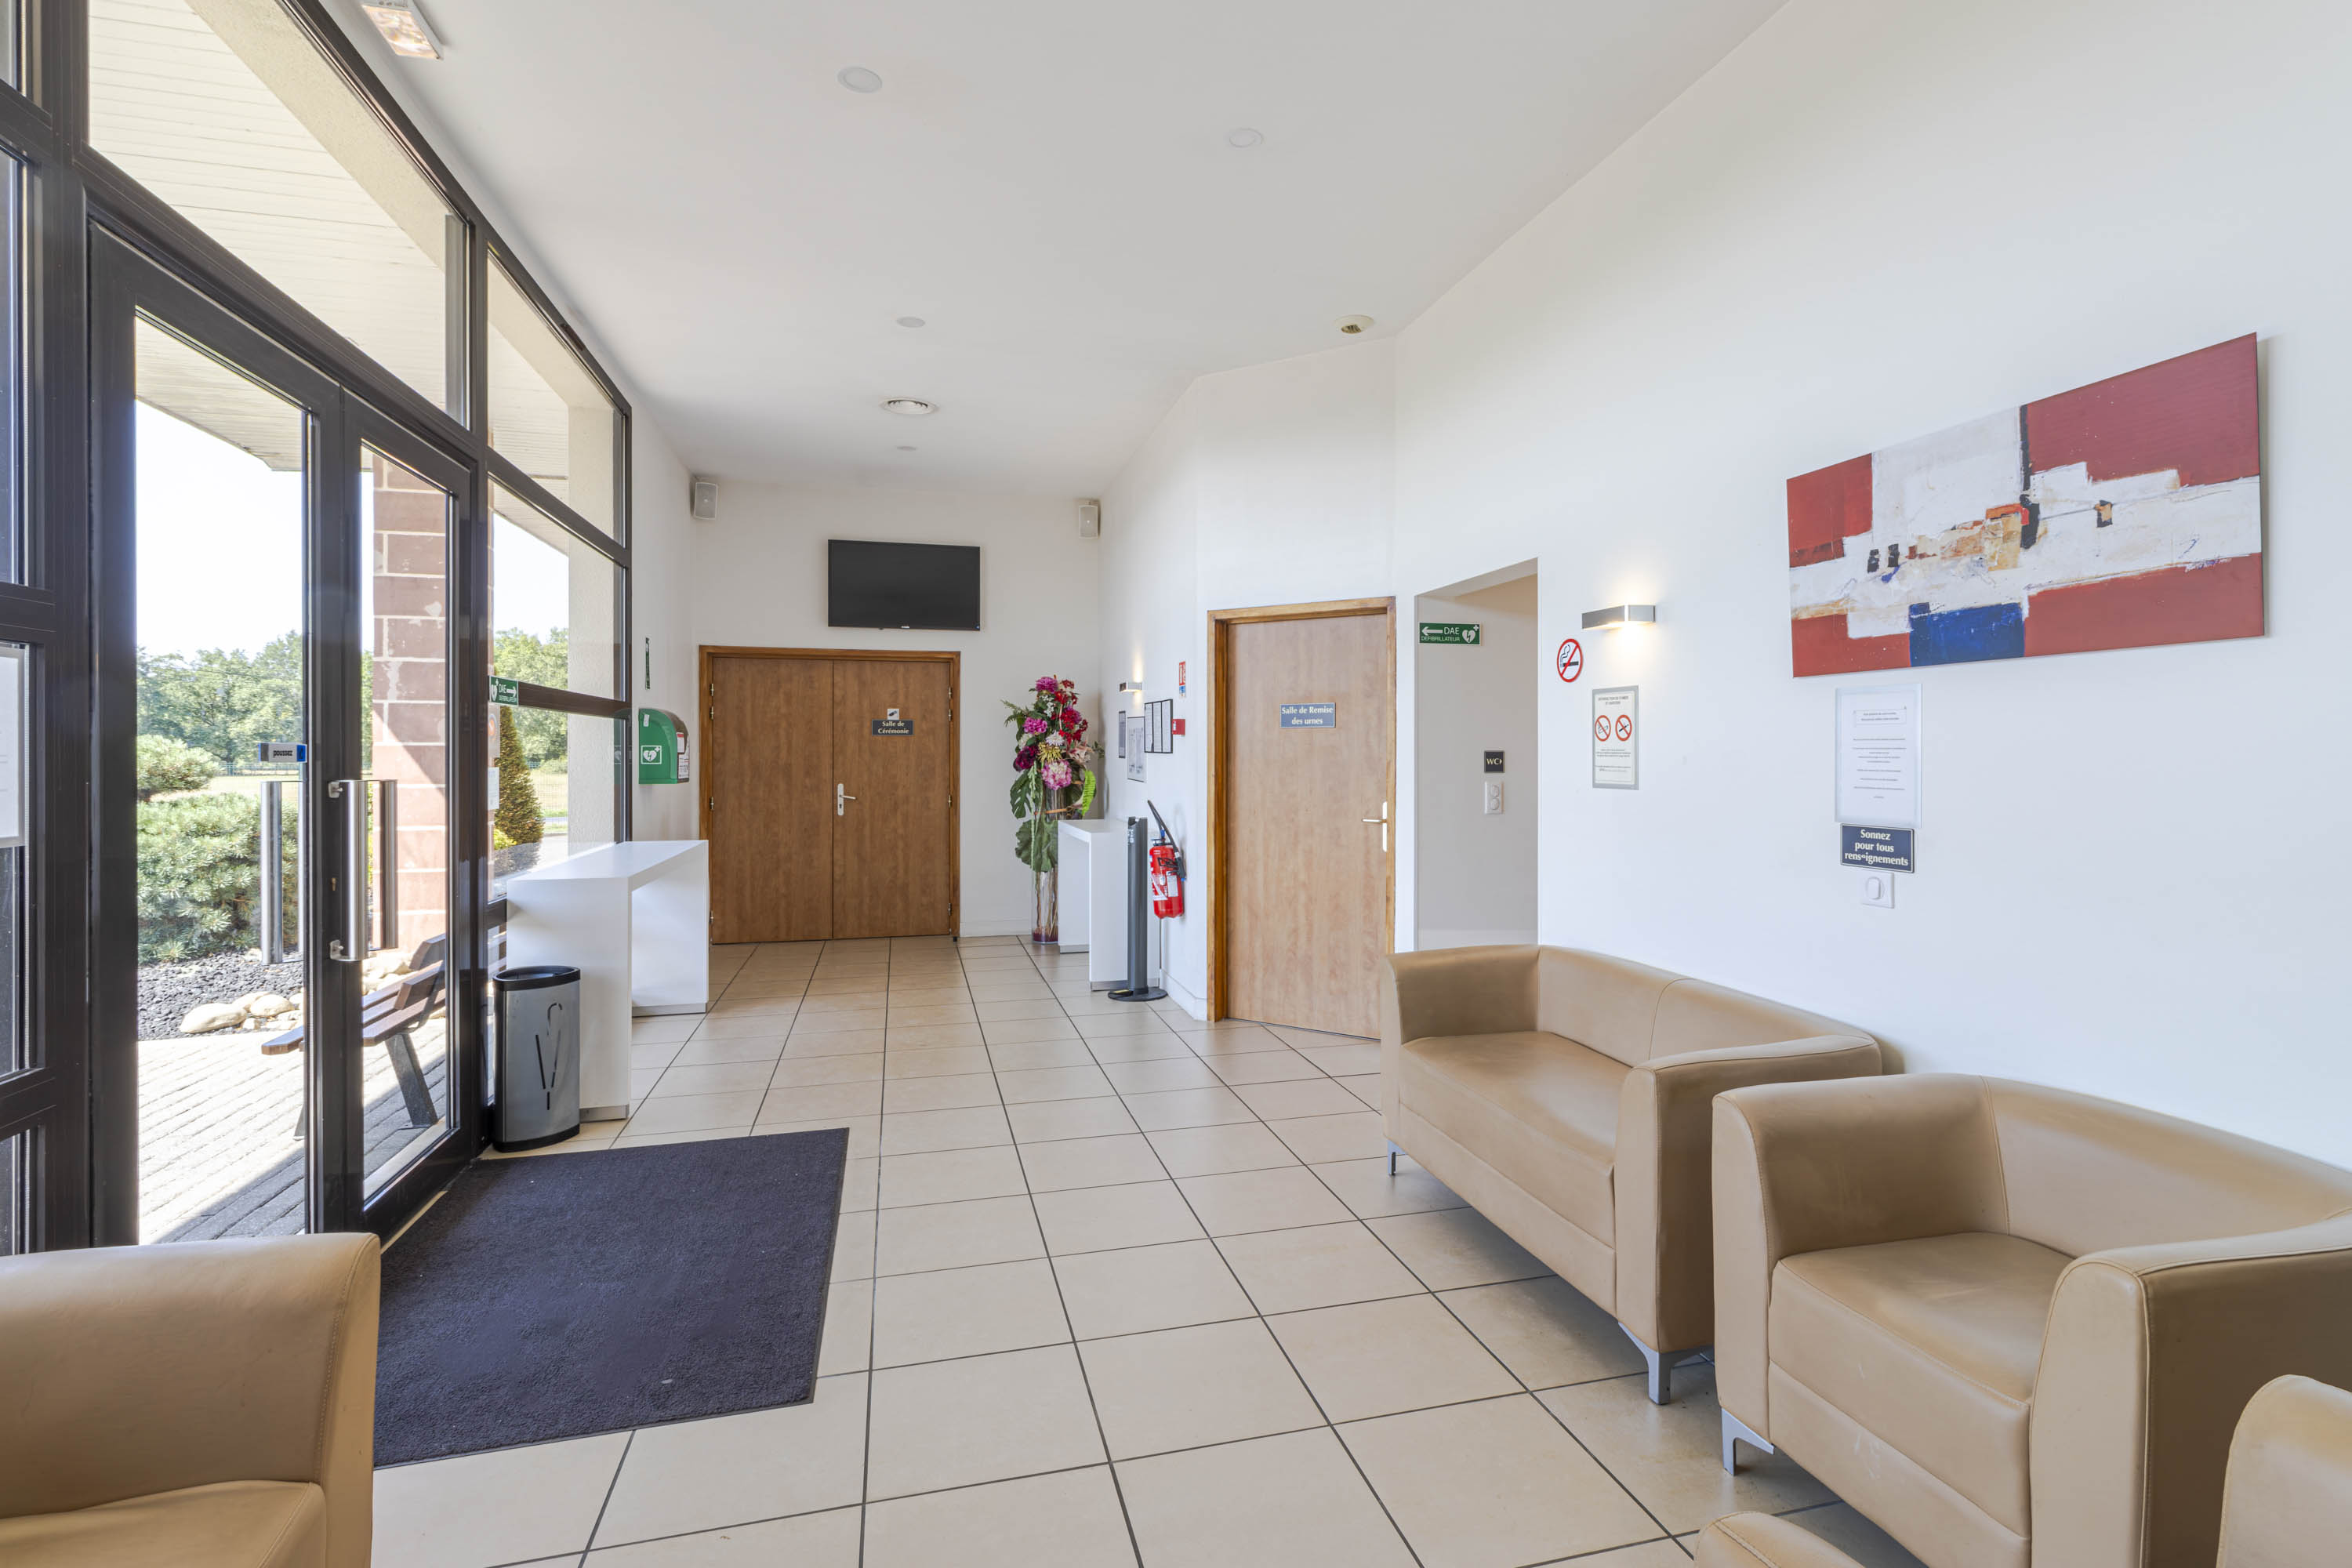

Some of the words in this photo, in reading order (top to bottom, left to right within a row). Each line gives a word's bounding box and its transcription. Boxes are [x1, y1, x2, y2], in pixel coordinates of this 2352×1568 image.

[1443, 626, 1459, 635] DAE
[1298, 706, 1308, 714] de
[1309, 706, 1333, 714] Remise
[1291, 717, 1302, 725] des
[273, 750, 293, 759] poussez
[1860, 829, 1891, 841] Sonnez
[1854, 841, 1875, 852] pour
[1875, 843, 1894, 853] tous
